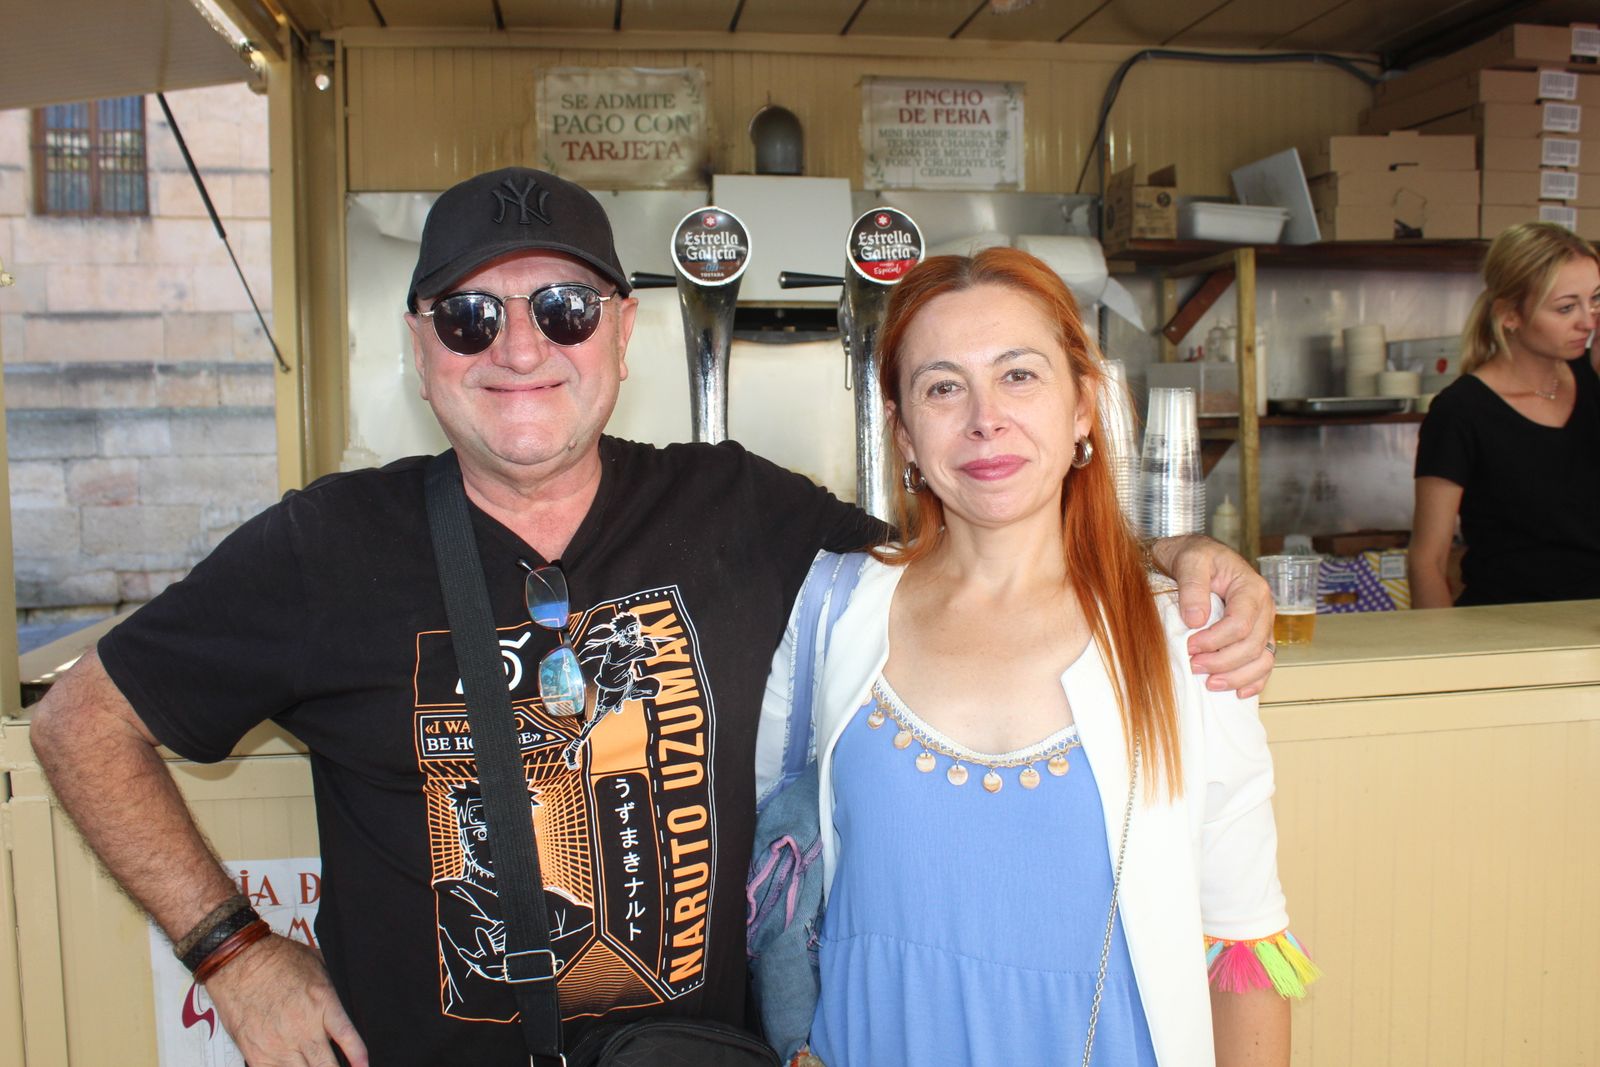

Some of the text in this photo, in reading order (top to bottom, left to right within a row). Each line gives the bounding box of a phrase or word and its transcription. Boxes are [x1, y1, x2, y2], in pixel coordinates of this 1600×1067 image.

[561, 93, 676, 110] SE ADMITE
[905, 89, 984, 106] PINCHO
[553, 113, 692, 135] PAGO CON
[899, 108, 991, 125] DE FERIA
[879, 129, 902, 138] MINI
[906, 129, 993, 138] HAMBURGUESA
[561, 141, 684, 161] TARJETA
[886, 139, 938, 148] TERNERA
[941, 139, 986, 148] CHARRA
[889, 149, 922, 158] CAMA
[925, 149, 940, 158] DE
[885, 159, 912, 168] FOIE
[914, 159, 922, 167] Y
[924, 159, 987, 169] CRUJIENTE
[920, 168, 972, 177] CEBOLLA
[492, 177, 552, 225] NY
[684, 231, 739, 245] Estrella
[858, 230, 912, 245] Estrella
[686, 245, 737, 260] Galicia
[861, 245, 910, 260] Galicia
[629, 600, 705, 792] UZUMAKI
[426, 737, 452, 751] BE
[613, 777, 646, 942] うずまきナルト
[668, 804, 709, 983] NARUTO
